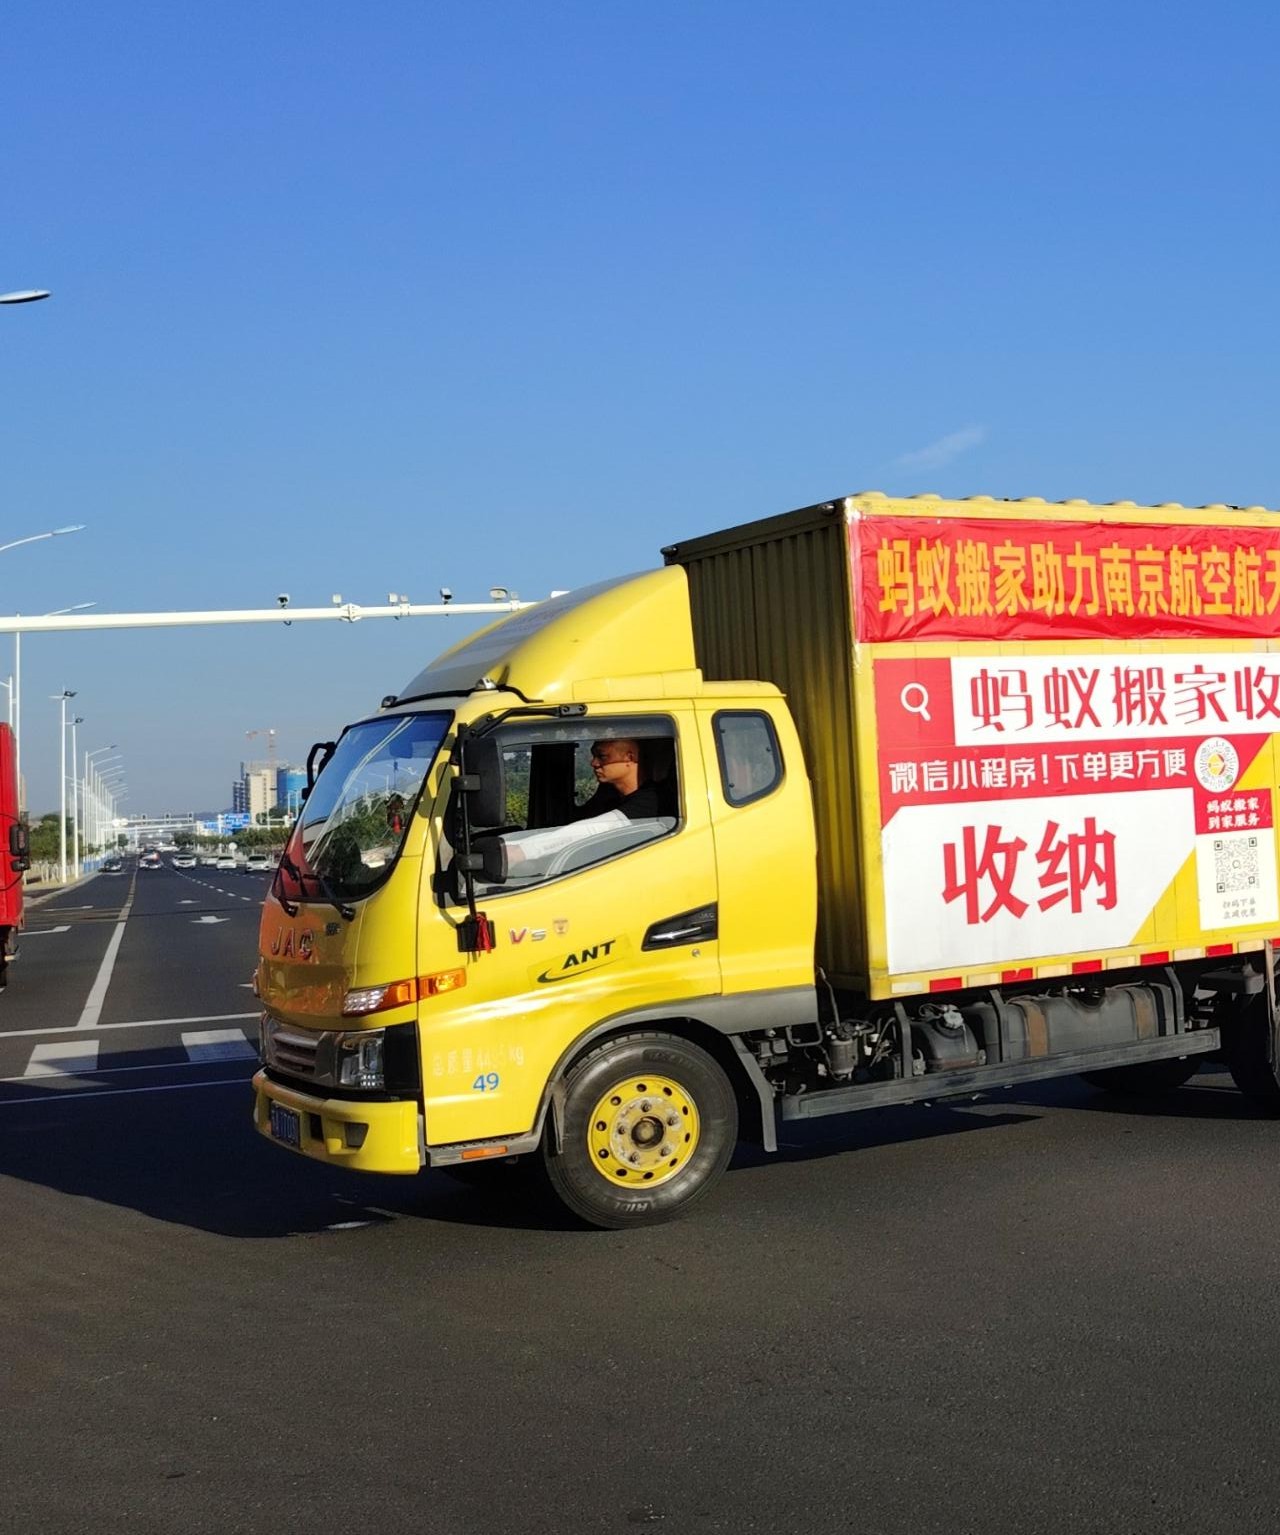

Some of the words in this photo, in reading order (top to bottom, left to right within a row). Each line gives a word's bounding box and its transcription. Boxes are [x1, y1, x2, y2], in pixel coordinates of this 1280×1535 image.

[1206, 797, 1260, 814] 蚂蚁搬家
[1207, 812, 1260, 830] 到家服务
[942, 817, 1118, 925] 收纳
[271, 926, 314, 960] JAC
[562, 940, 617, 970] ANT
[473, 1072, 500, 1092] 49
